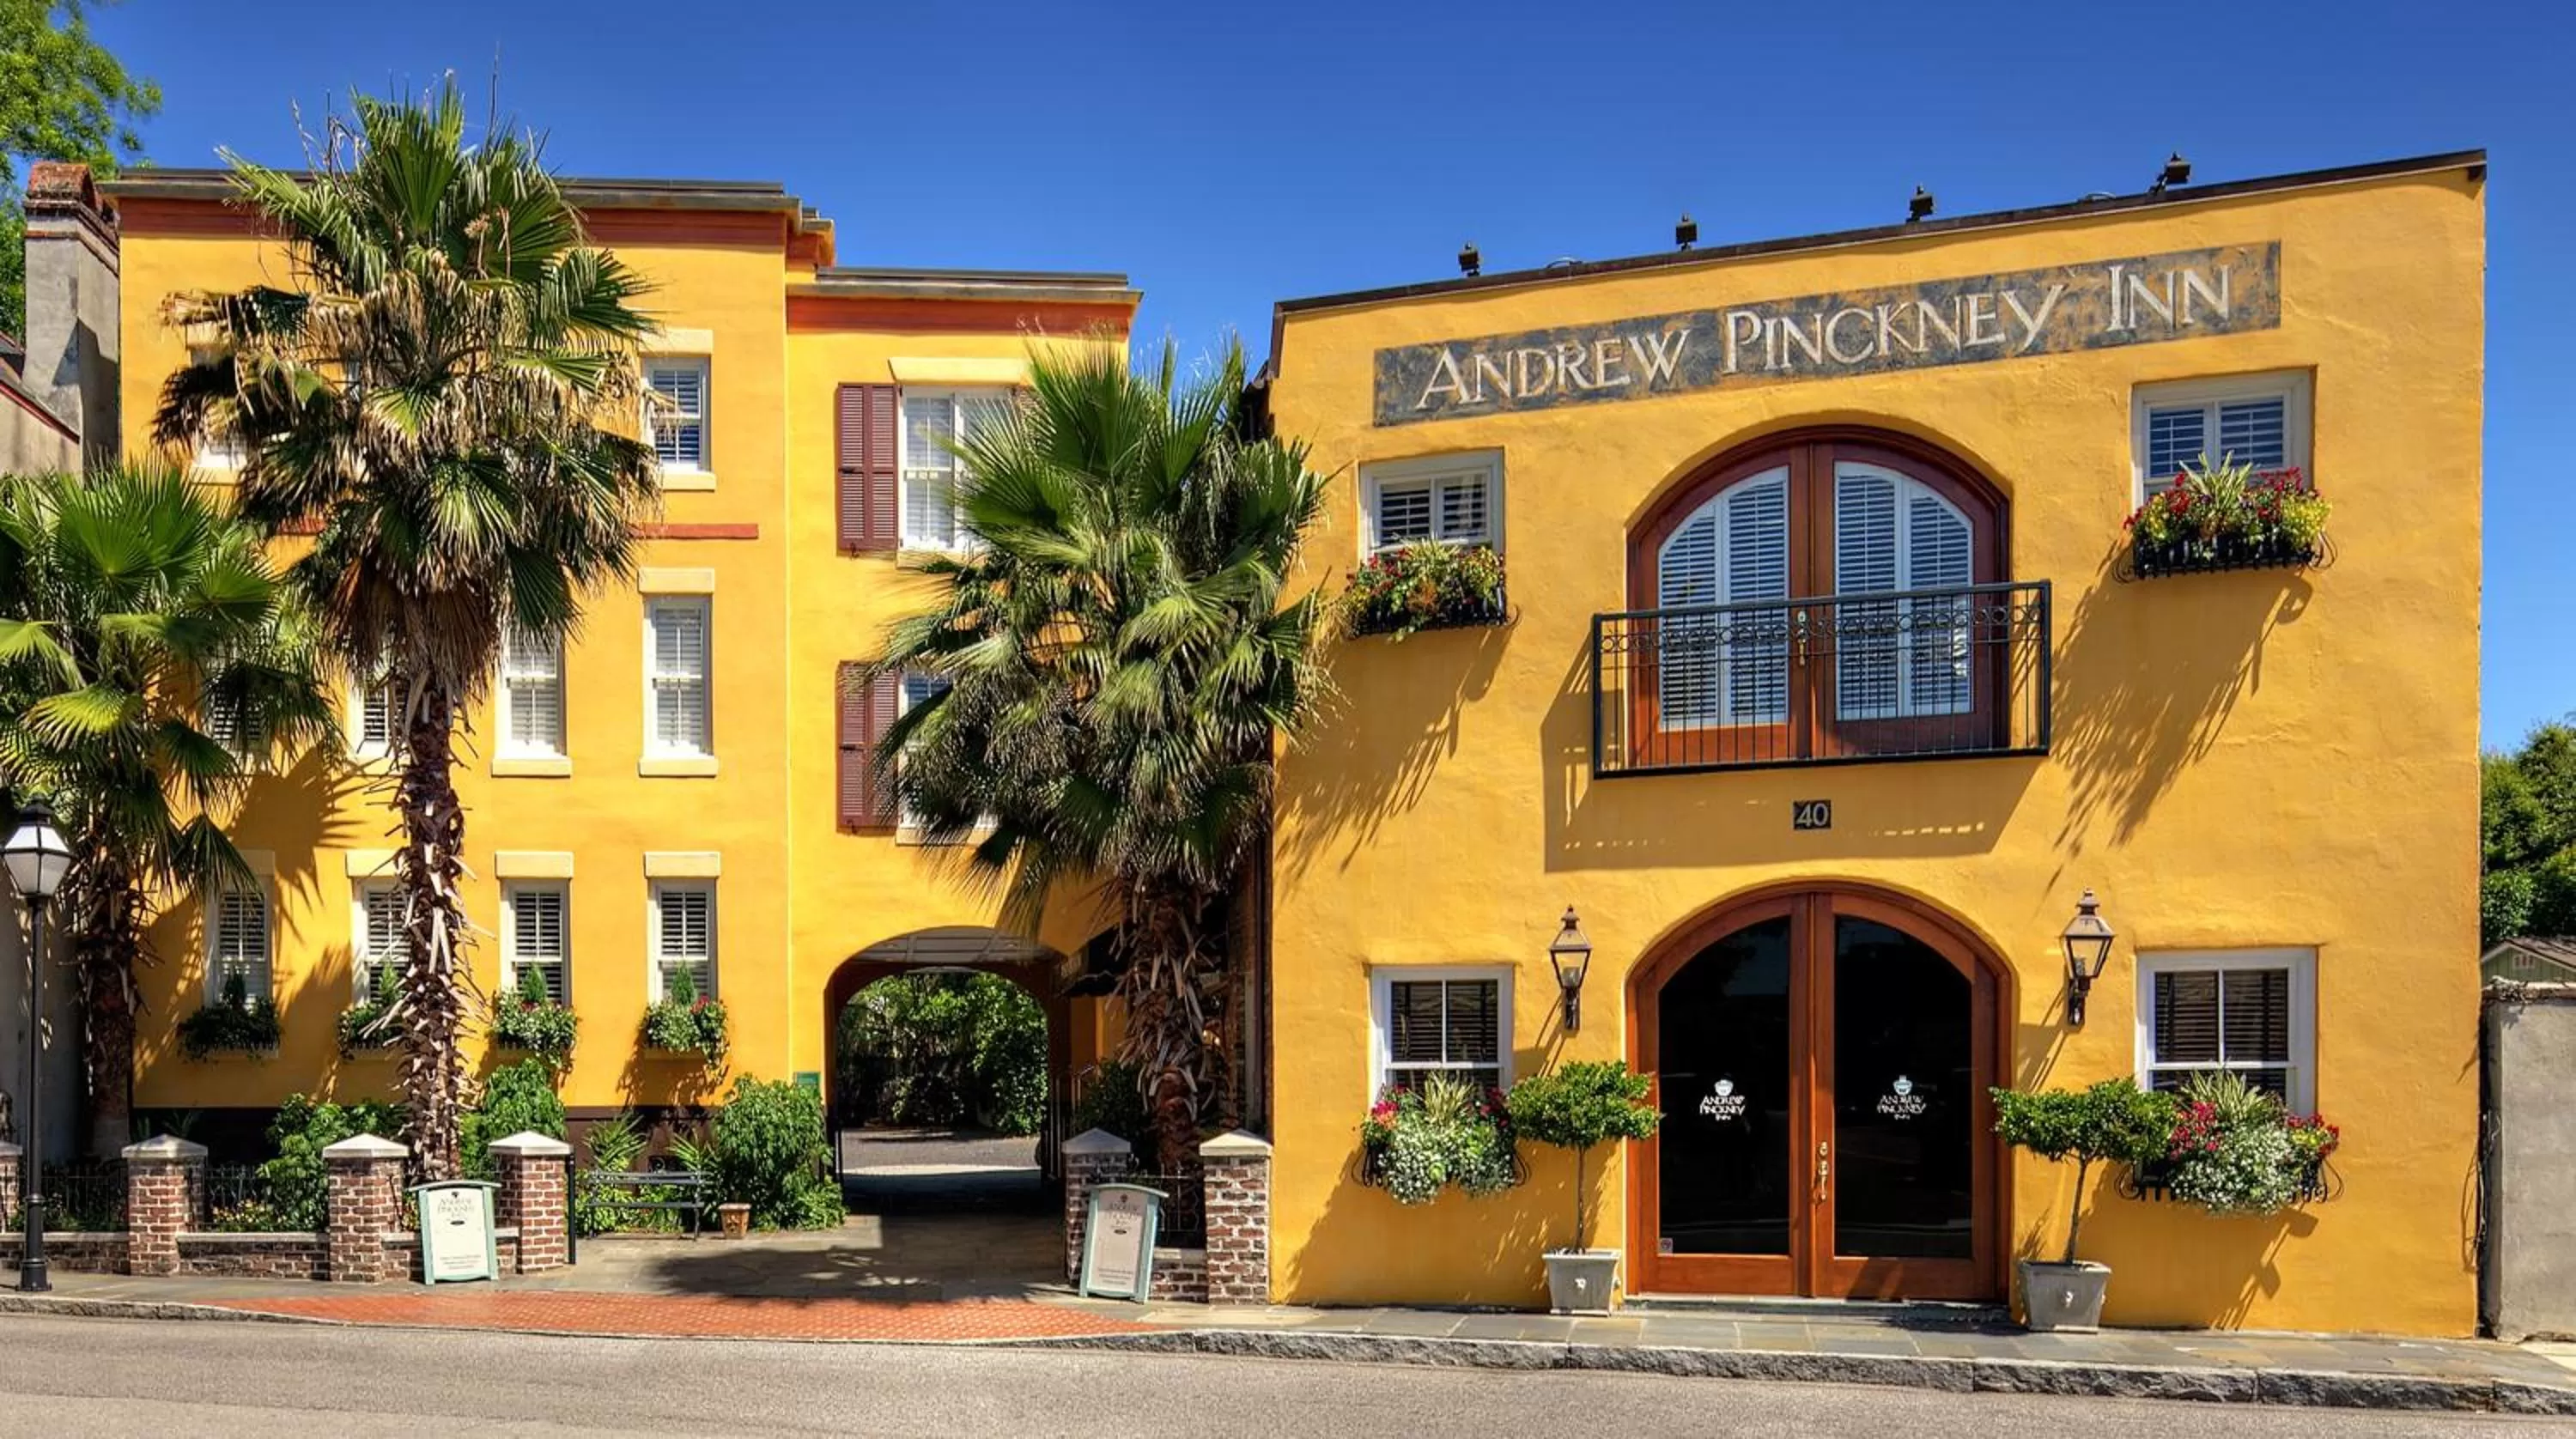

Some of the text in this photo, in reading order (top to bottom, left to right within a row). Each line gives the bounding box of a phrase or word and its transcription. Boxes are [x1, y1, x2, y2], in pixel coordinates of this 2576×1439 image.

[1415, 264, 2230, 410] ANDREW PINCKNEY INN
[1795, 803, 1829, 827] 40
